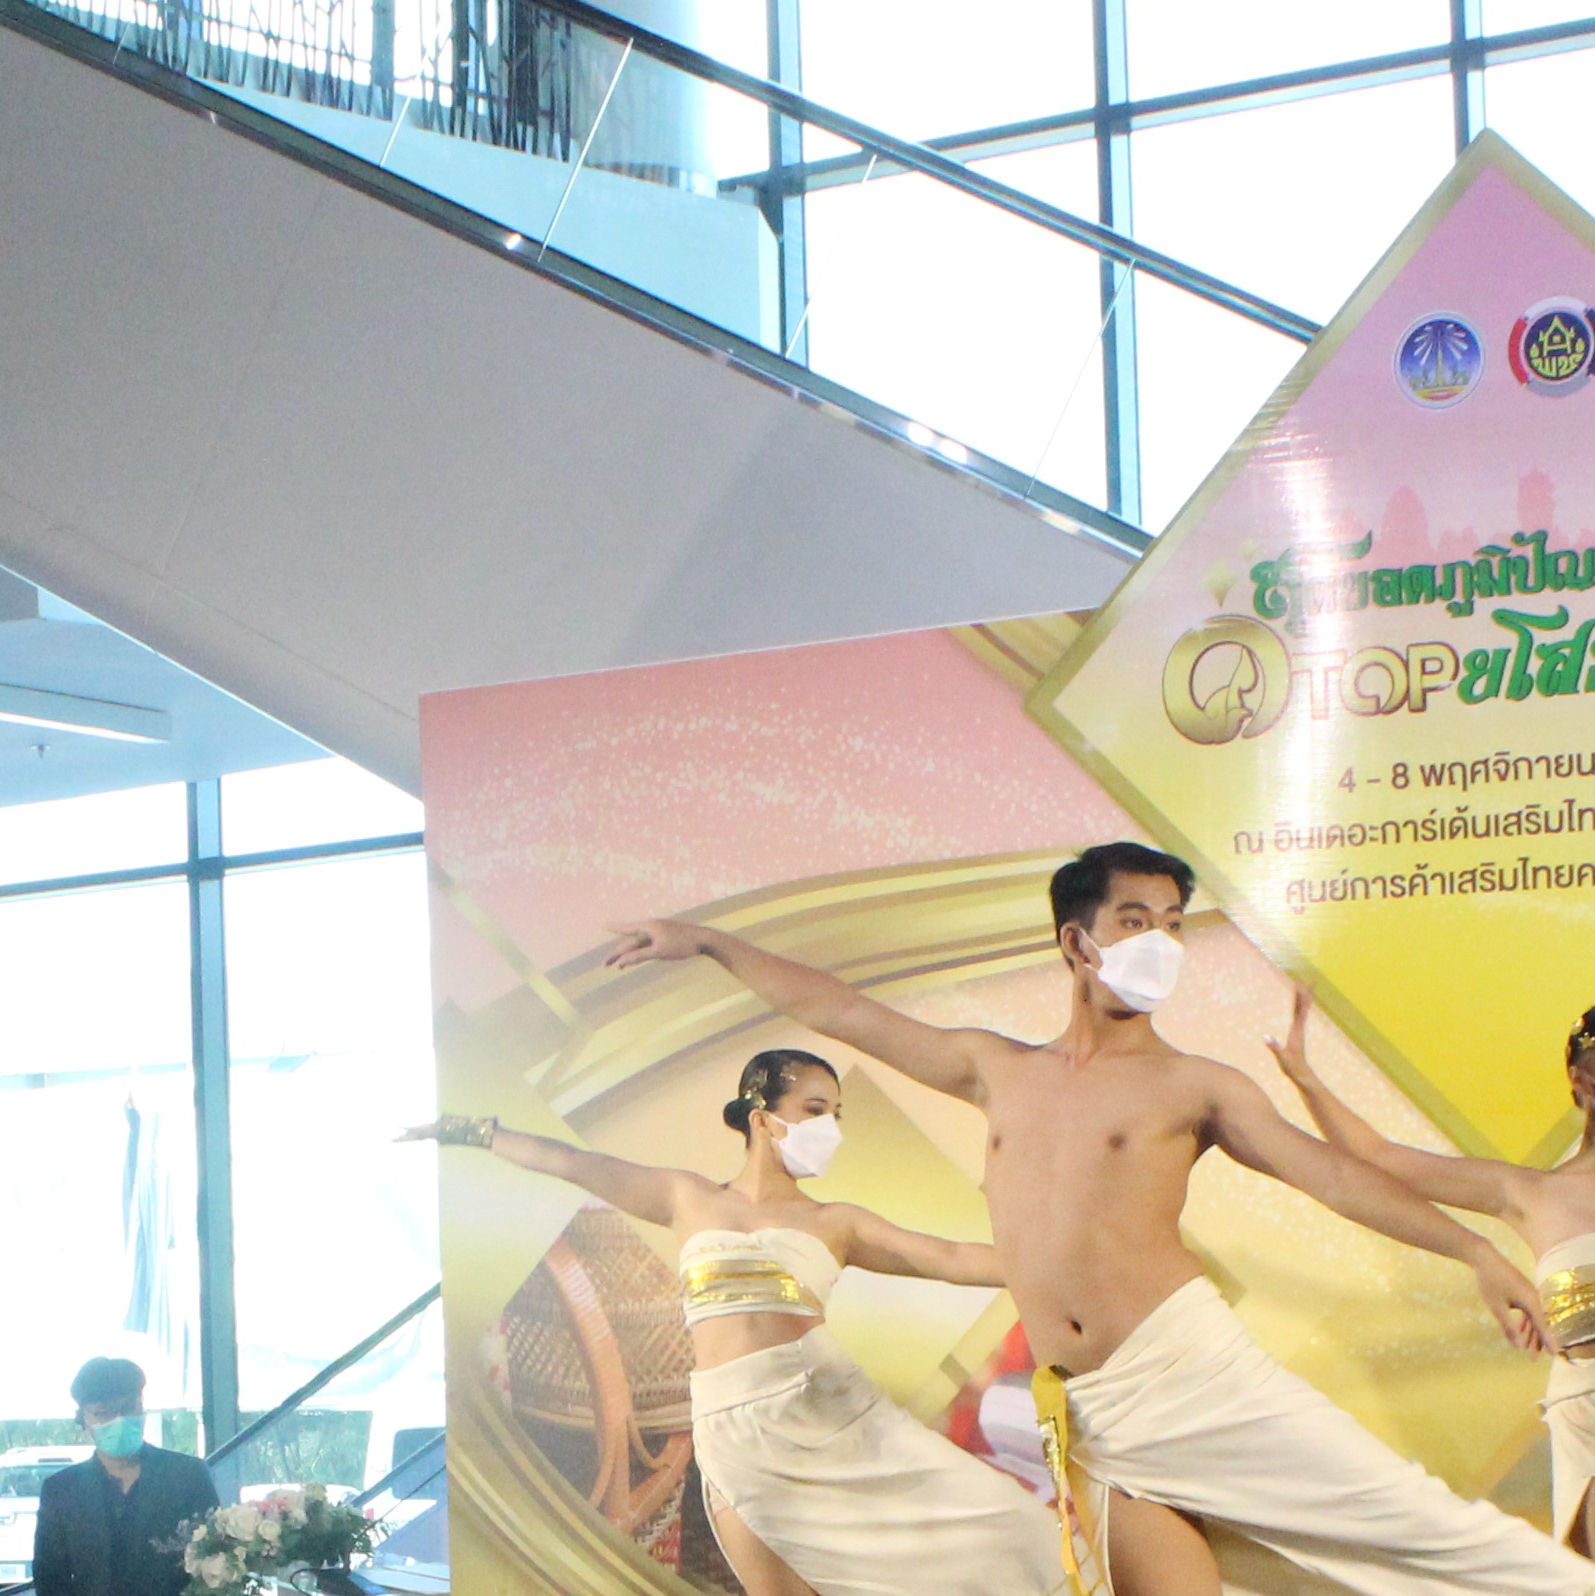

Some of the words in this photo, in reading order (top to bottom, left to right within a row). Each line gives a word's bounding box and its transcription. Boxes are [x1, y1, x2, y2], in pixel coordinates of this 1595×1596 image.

[1163, 615, 1459, 745] OTOP
[1338, 768, 1356, 793] 4
[1391, 763, 1410, 789] 8
[1233, 830, 1264, 855] ณ
